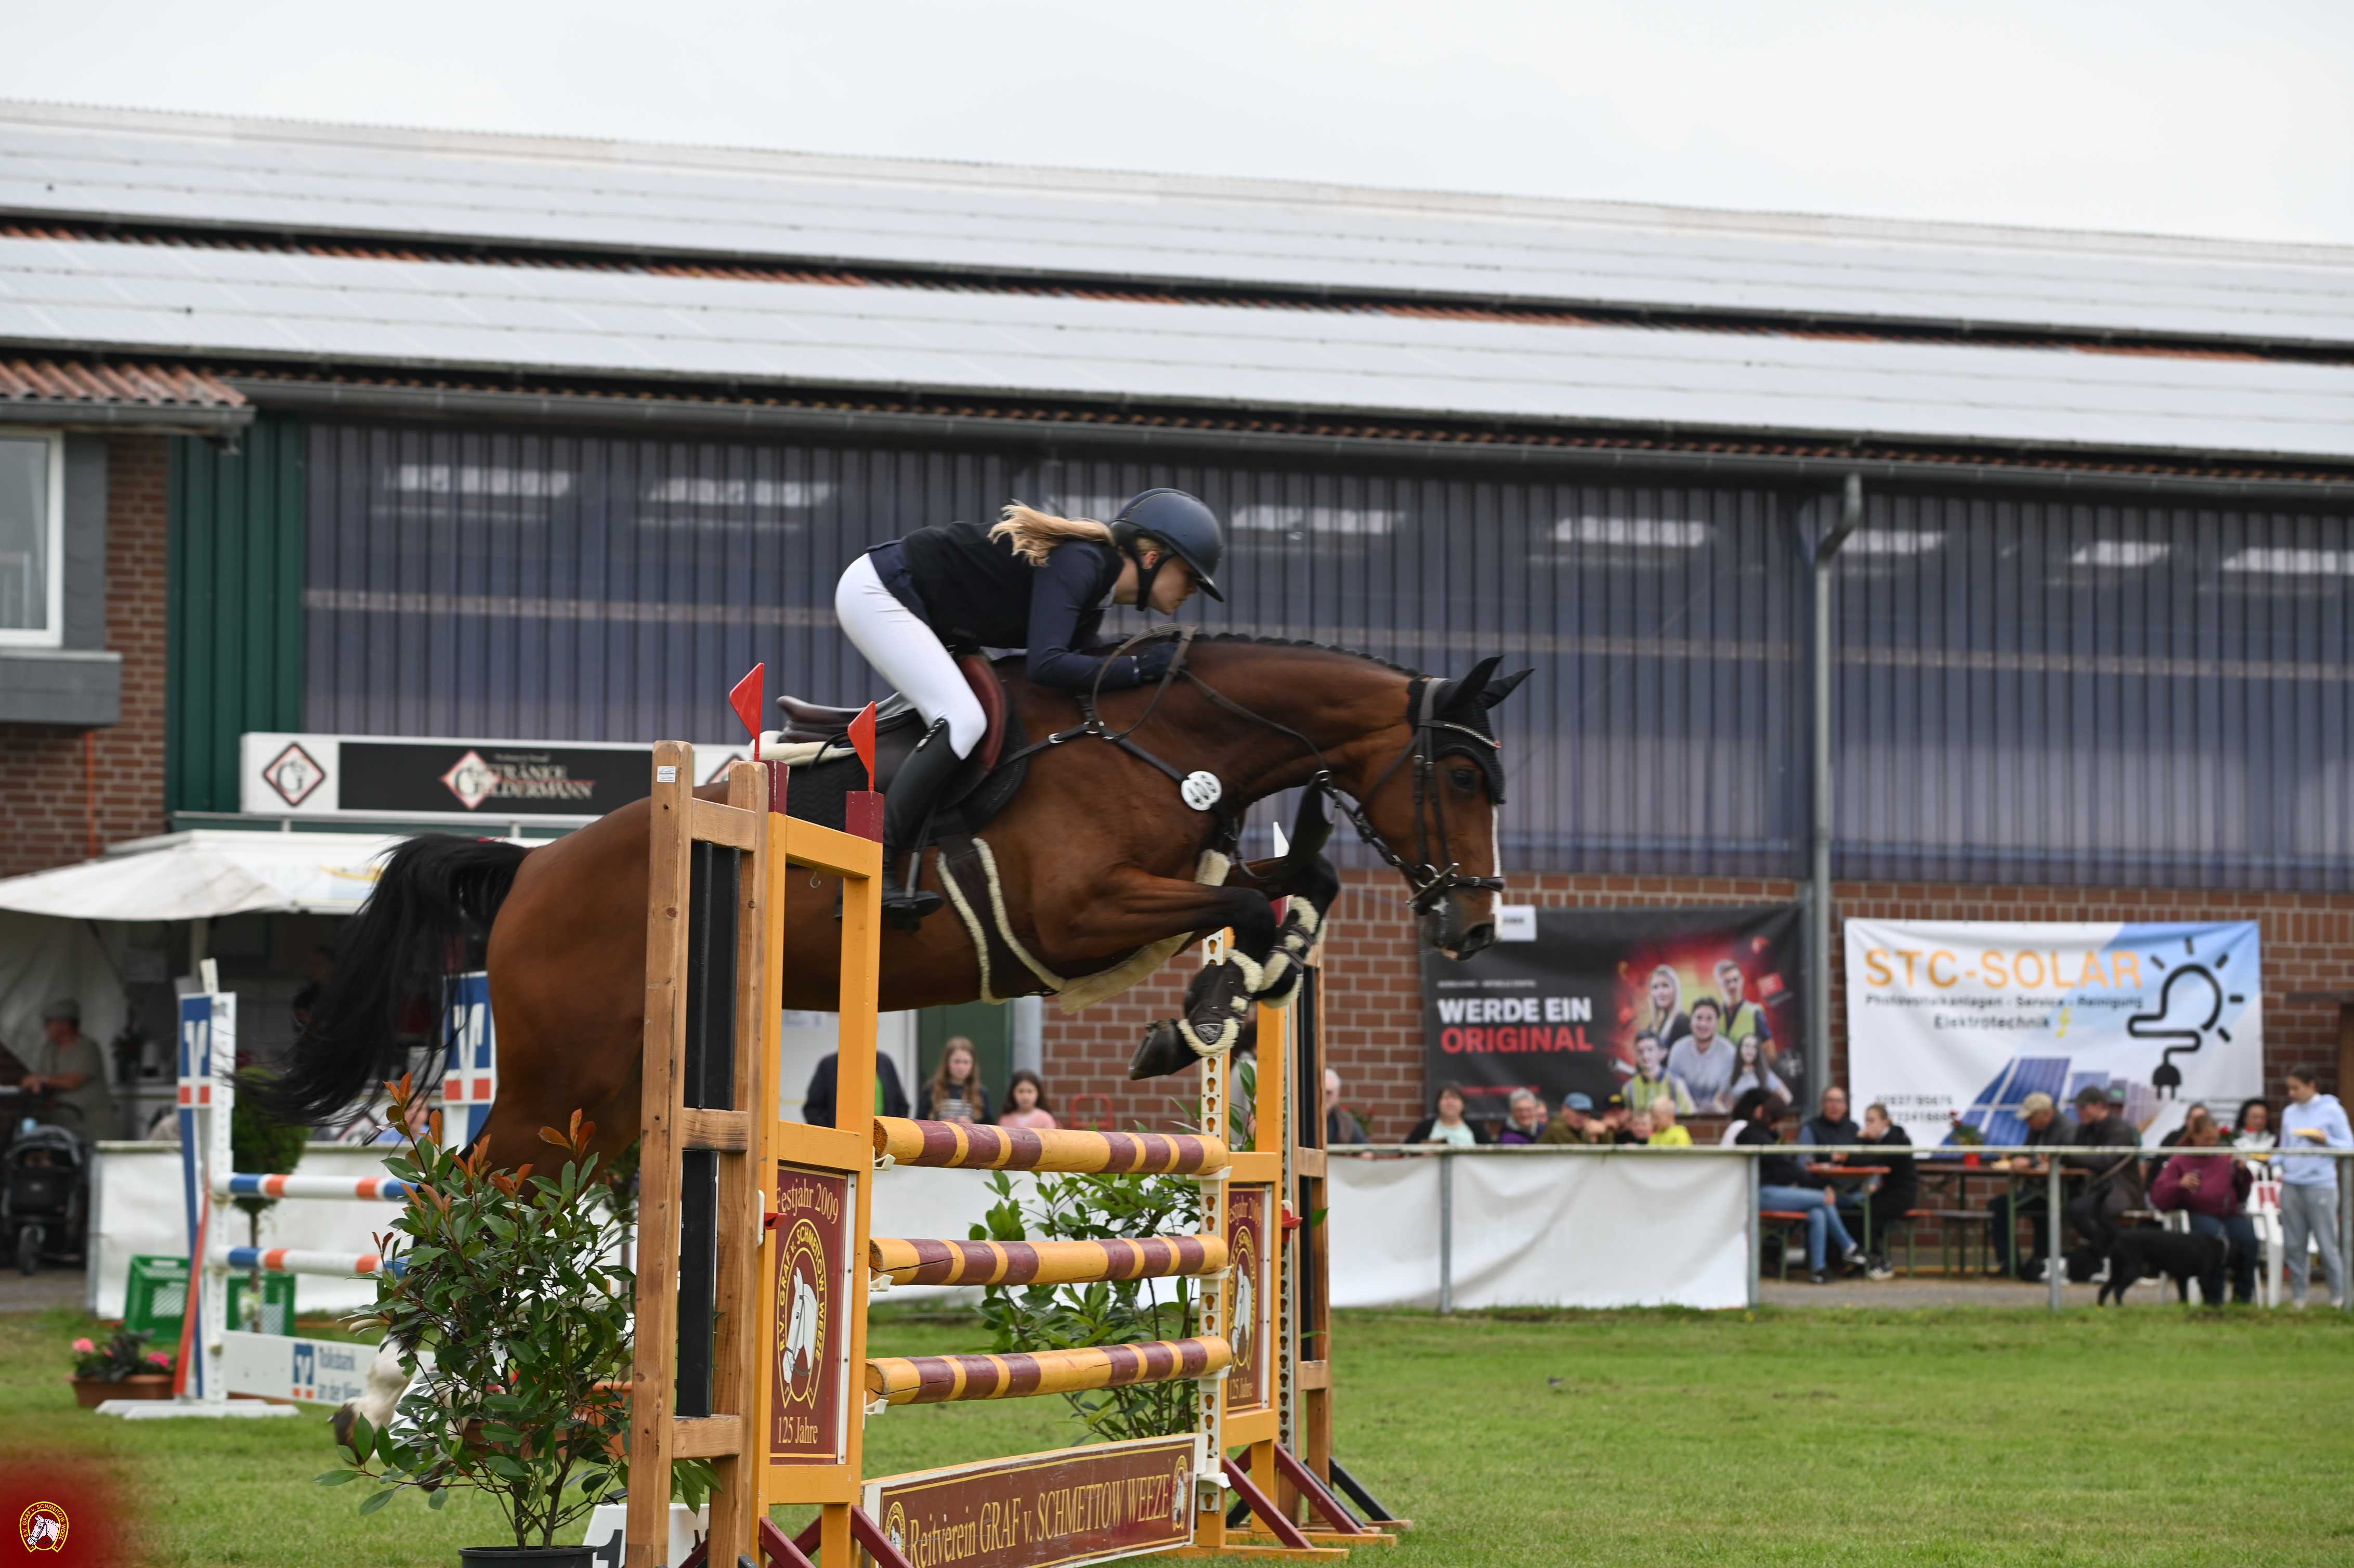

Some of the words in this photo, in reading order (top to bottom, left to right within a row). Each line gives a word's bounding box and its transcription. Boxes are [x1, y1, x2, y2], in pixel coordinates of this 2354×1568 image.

[1865, 949, 2143, 988] STC-SOLAR
[1437, 997, 1540, 1024] WERDE
[1545, 997, 1592, 1022] EIN
[2016, 995, 2063, 1007] Service
[1440, 1025, 1593, 1054] ORIGINAL
[815, 1183, 839, 1224] 2009
[1228, 1195, 1248, 1225] estjahr
[780, 1250, 791, 1306] GRAF
[796, 1226, 825, 1291] SCHMETTOW
[815, 1302, 825, 1361] WEEZE
[778, 1416, 793, 1444] 125
[795, 1416, 818, 1444] Jahre
[909, 1506, 976, 1568] Reitverein
[979, 1498, 1021, 1553] GRAF
[1024, 1510, 1033, 1544] v.
[1037, 1480, 1126, 1541] SCHMETTOW
[1127, 1474, 1170, 1523] WEEZE
